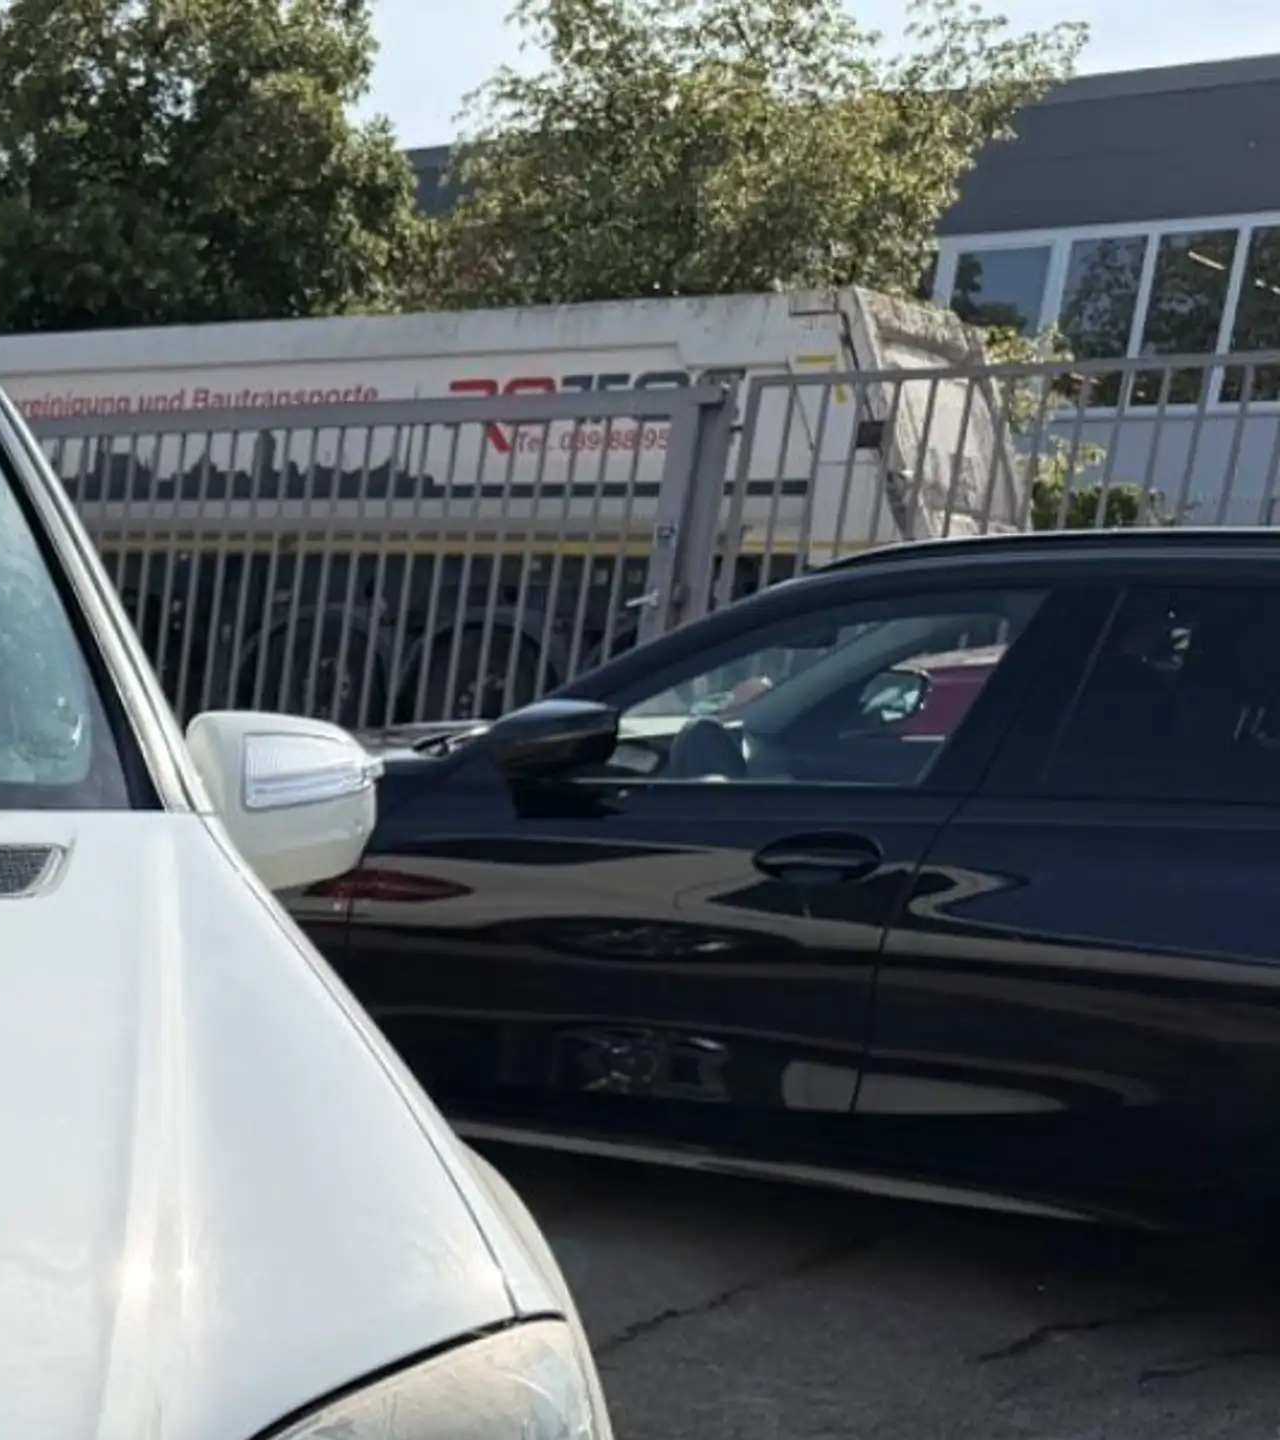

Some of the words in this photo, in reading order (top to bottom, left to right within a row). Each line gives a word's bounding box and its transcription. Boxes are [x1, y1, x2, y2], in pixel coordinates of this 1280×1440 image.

[17, 390, 131, 420] reinigung
[138, 387, 186, 412] und
[193, 383, 379, 410] Bautransporte
